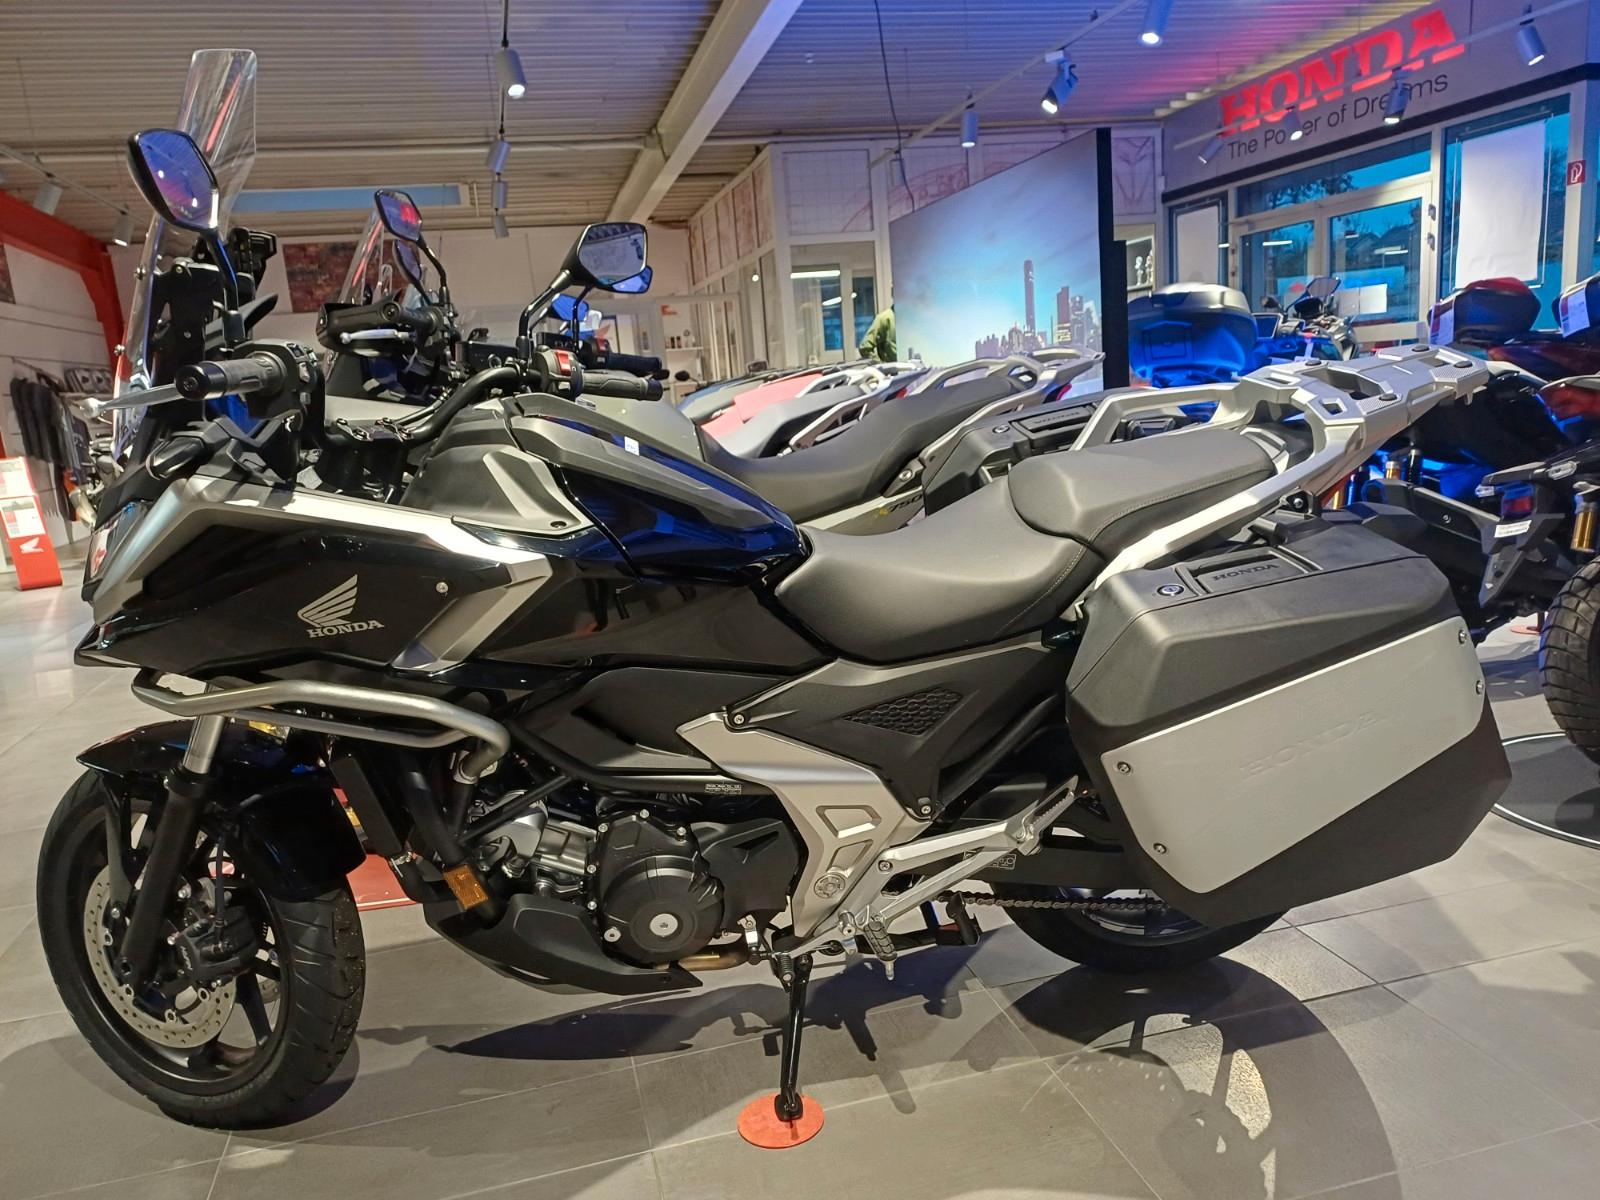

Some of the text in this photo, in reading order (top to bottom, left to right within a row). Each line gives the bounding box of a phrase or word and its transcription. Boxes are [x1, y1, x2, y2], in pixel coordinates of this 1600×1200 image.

[1219, 9, 1465, 138] HONDA
[1228, 73, 1449, 160] The Poer of Drems
[1212, 563, 1280, 581] HONDA
[306, 619, 385, 638] HONDA
[1239, 710, 1392, 782] HONDA
